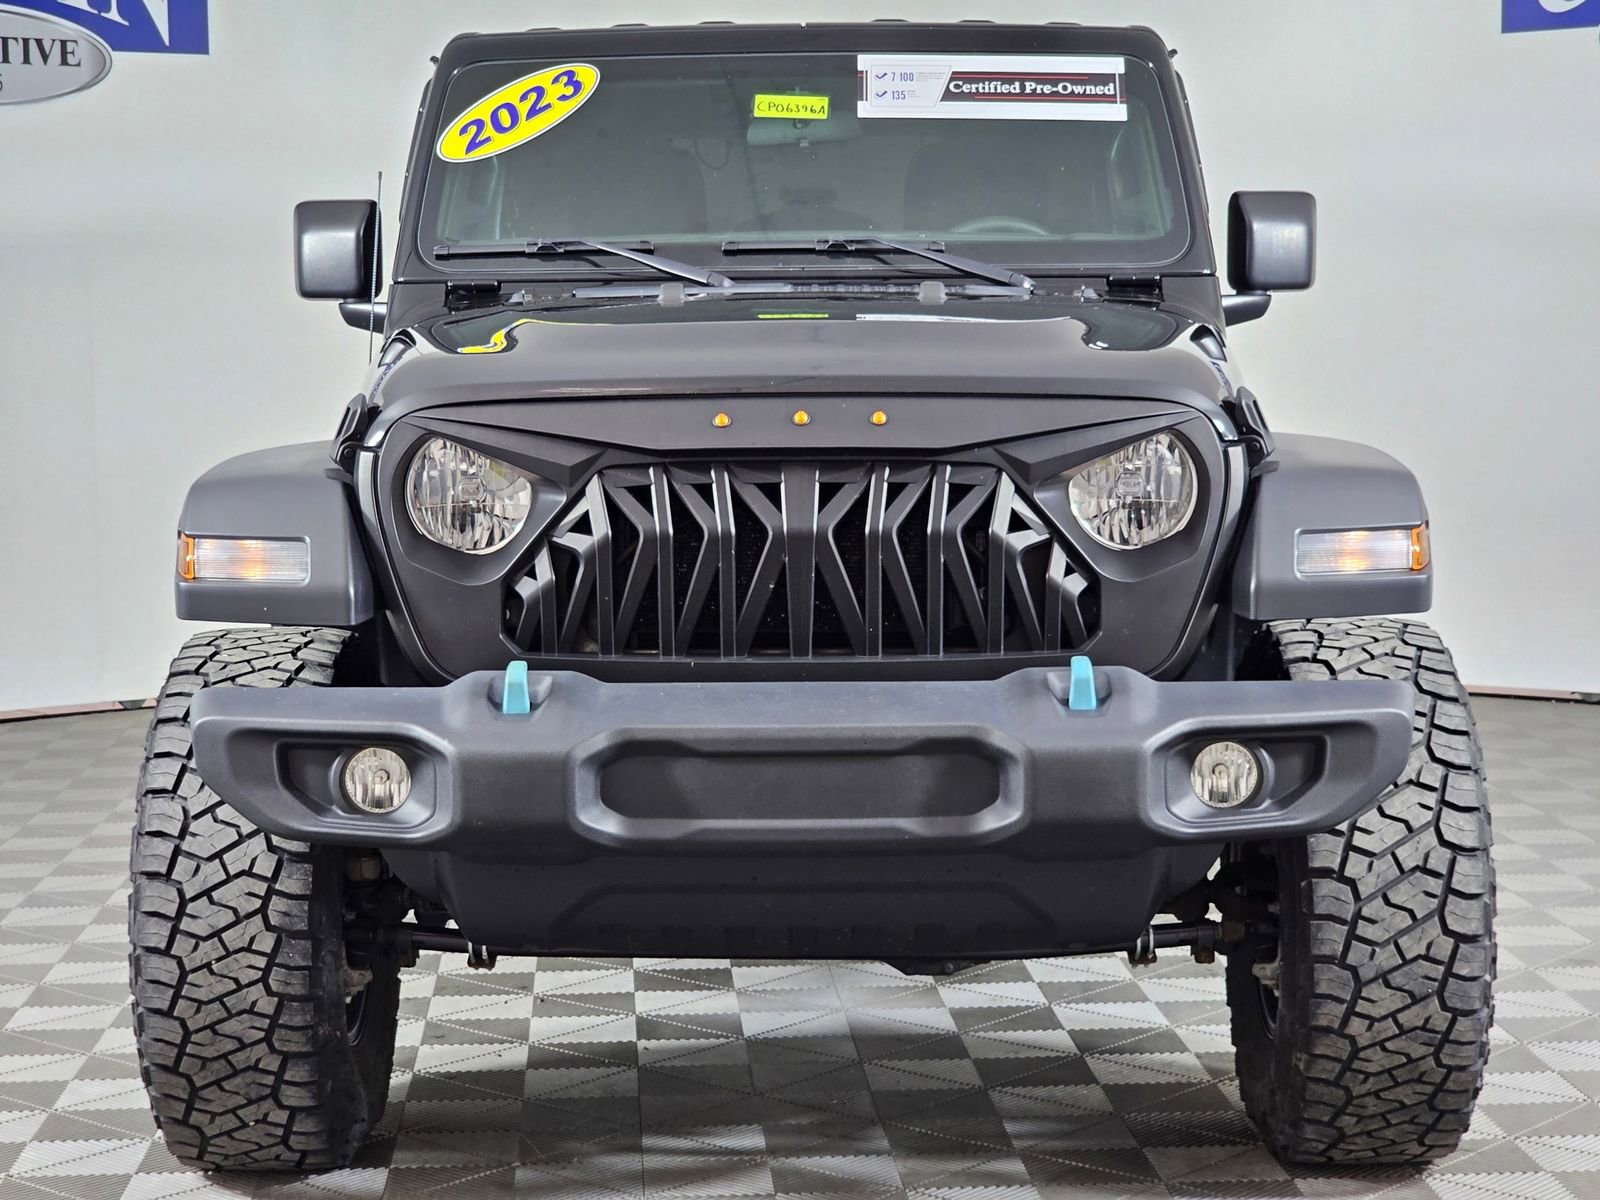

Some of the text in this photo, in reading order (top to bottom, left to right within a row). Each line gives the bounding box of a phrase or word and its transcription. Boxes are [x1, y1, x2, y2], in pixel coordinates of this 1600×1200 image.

[949, 80, 1115, 95] Certified Pre-Owned
[891, 90, 906, 101] 135
[458, 69, 583, 155] 2023
